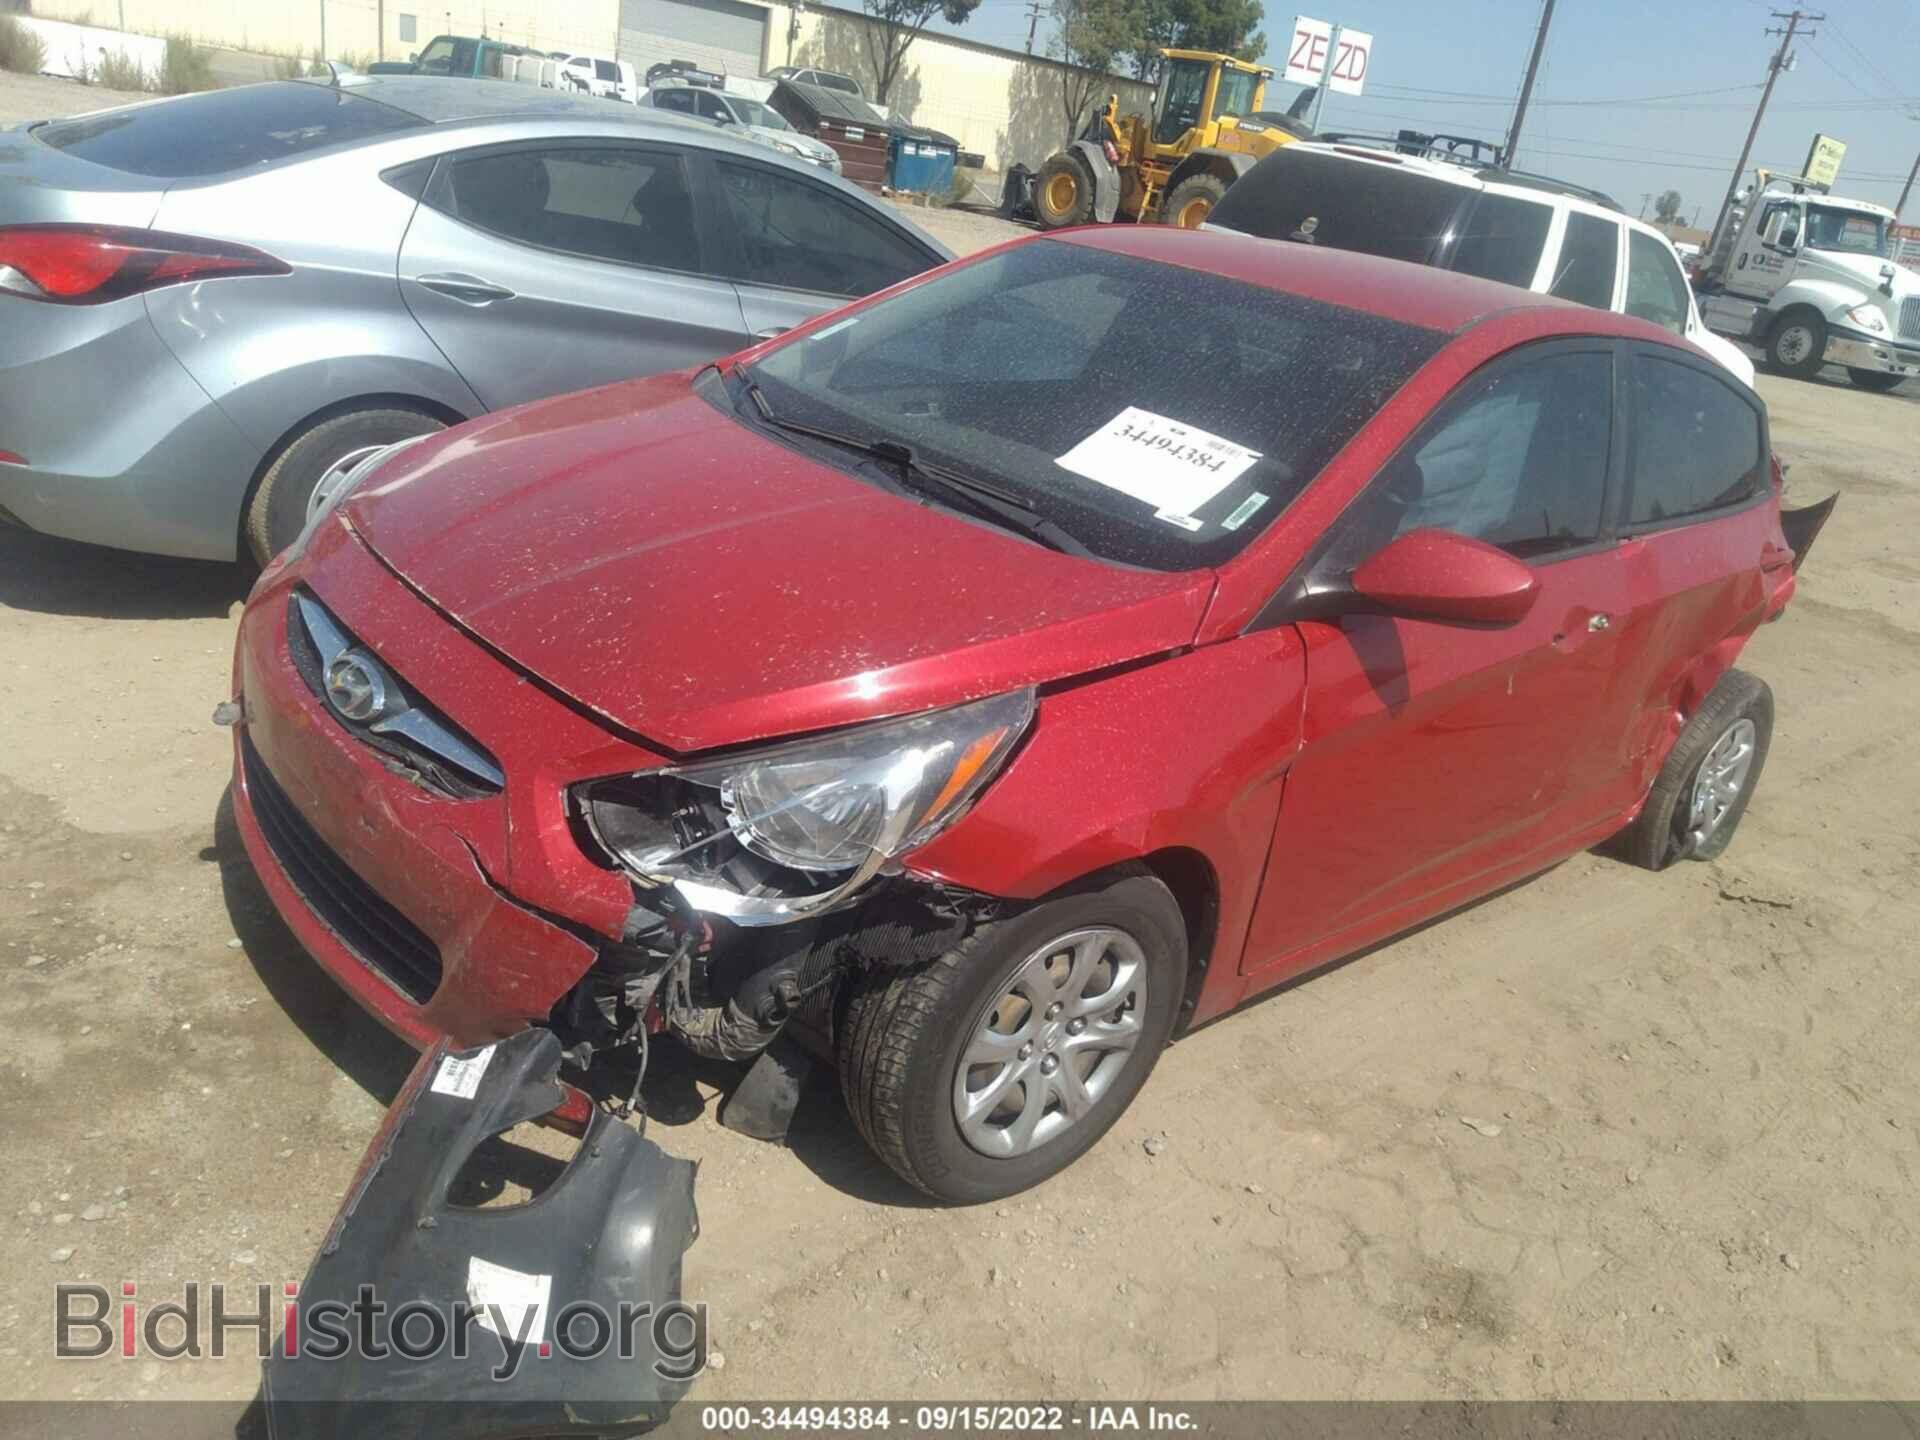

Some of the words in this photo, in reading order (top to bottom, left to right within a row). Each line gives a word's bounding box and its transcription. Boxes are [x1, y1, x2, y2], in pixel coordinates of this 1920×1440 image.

[1288, 30, 1328, 73] ZE
[1331, 42, 1367, 81] ZD
[1113, 424, 1226, 472] 34494384
